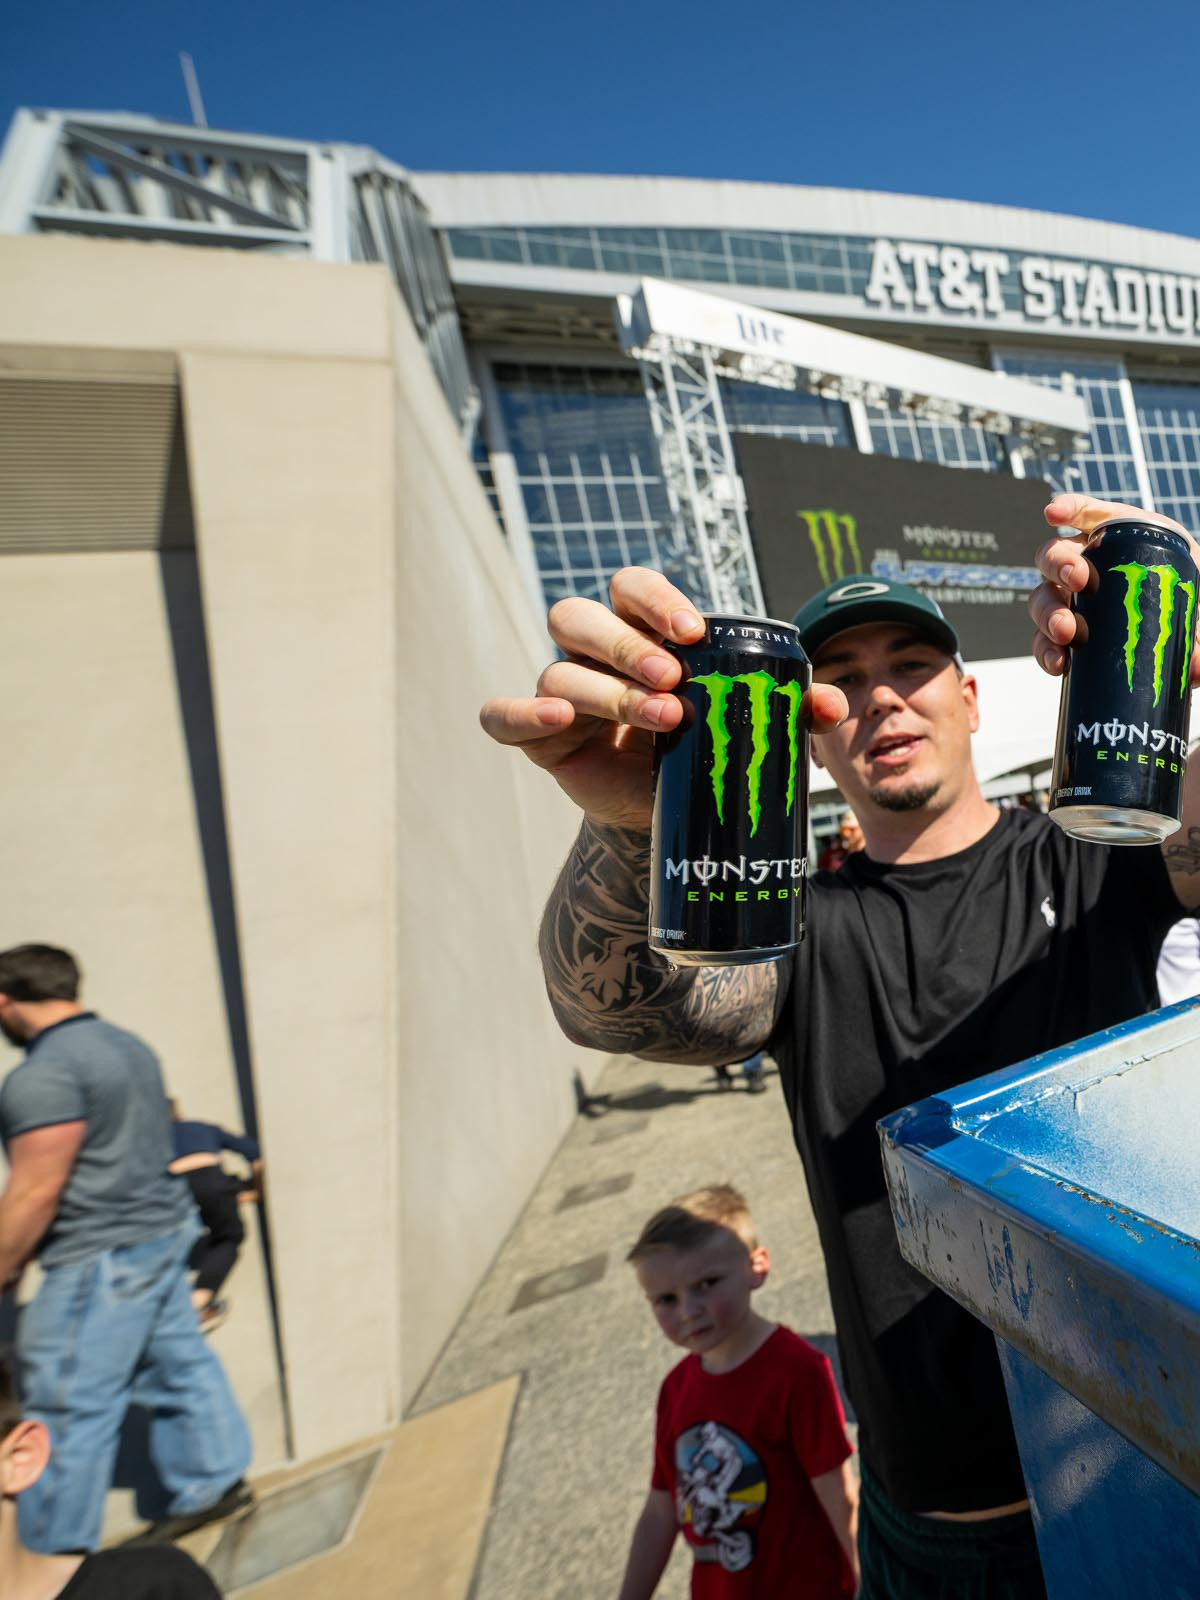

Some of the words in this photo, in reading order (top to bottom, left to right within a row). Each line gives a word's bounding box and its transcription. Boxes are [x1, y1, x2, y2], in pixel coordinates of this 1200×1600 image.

[865, 238, 1010, 313] AT&T
[714, 626, 790, 645] TAURINE
[665, 854, 808, 887] MONSTER
[687, 887, 800, 902] ENERGY
